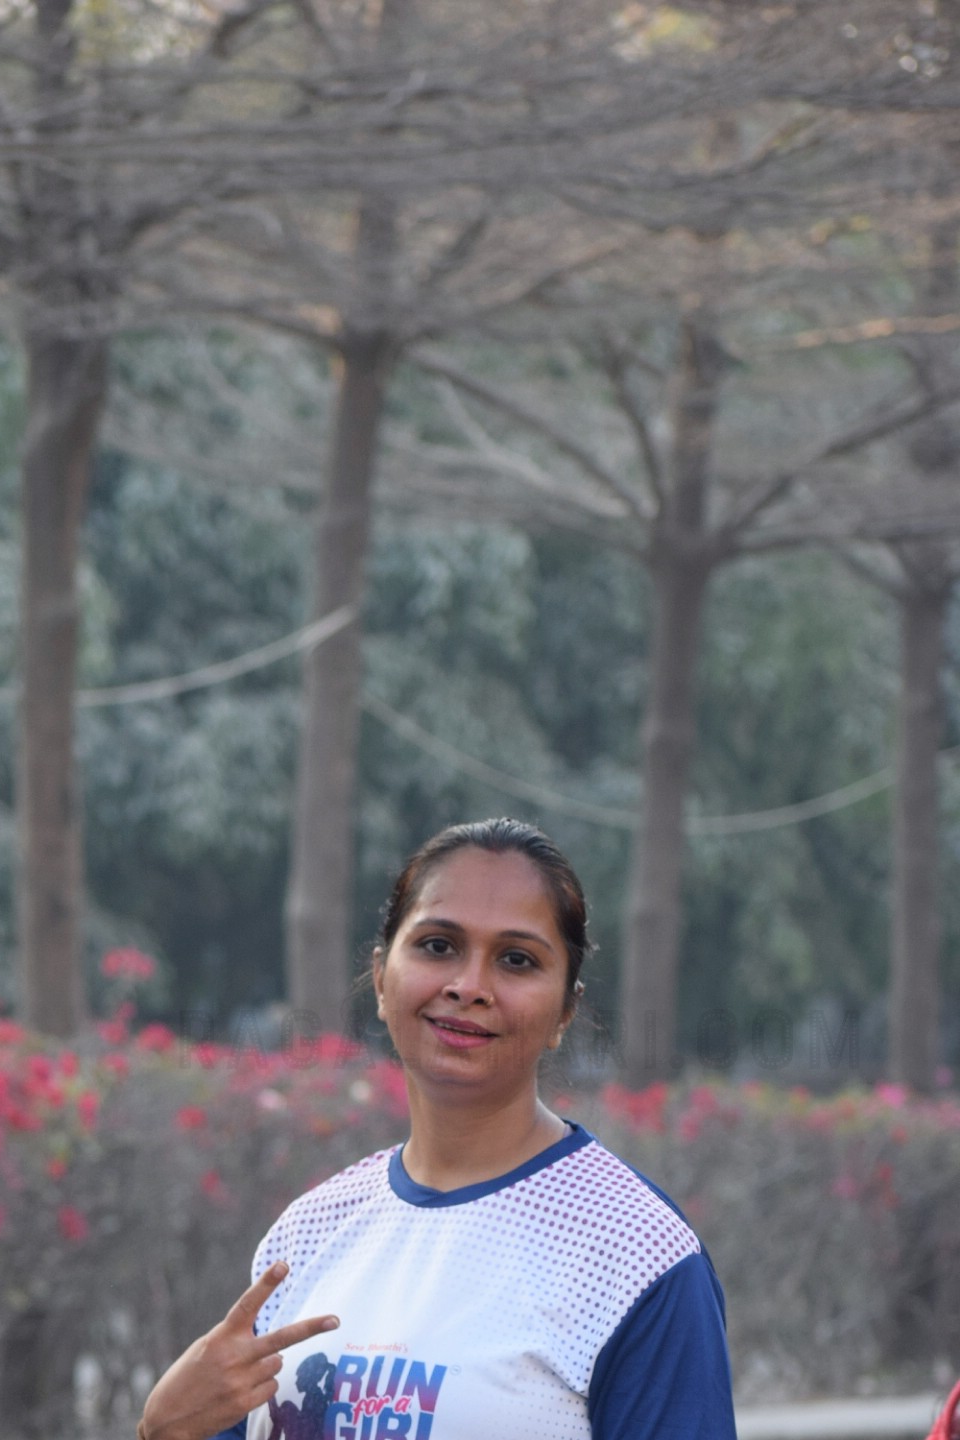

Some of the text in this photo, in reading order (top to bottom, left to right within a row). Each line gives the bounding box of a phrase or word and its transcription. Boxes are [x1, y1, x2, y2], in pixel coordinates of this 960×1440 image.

[332, 1354, 447, 1413] RUN
[352, 1395, 410, 1426] for a
